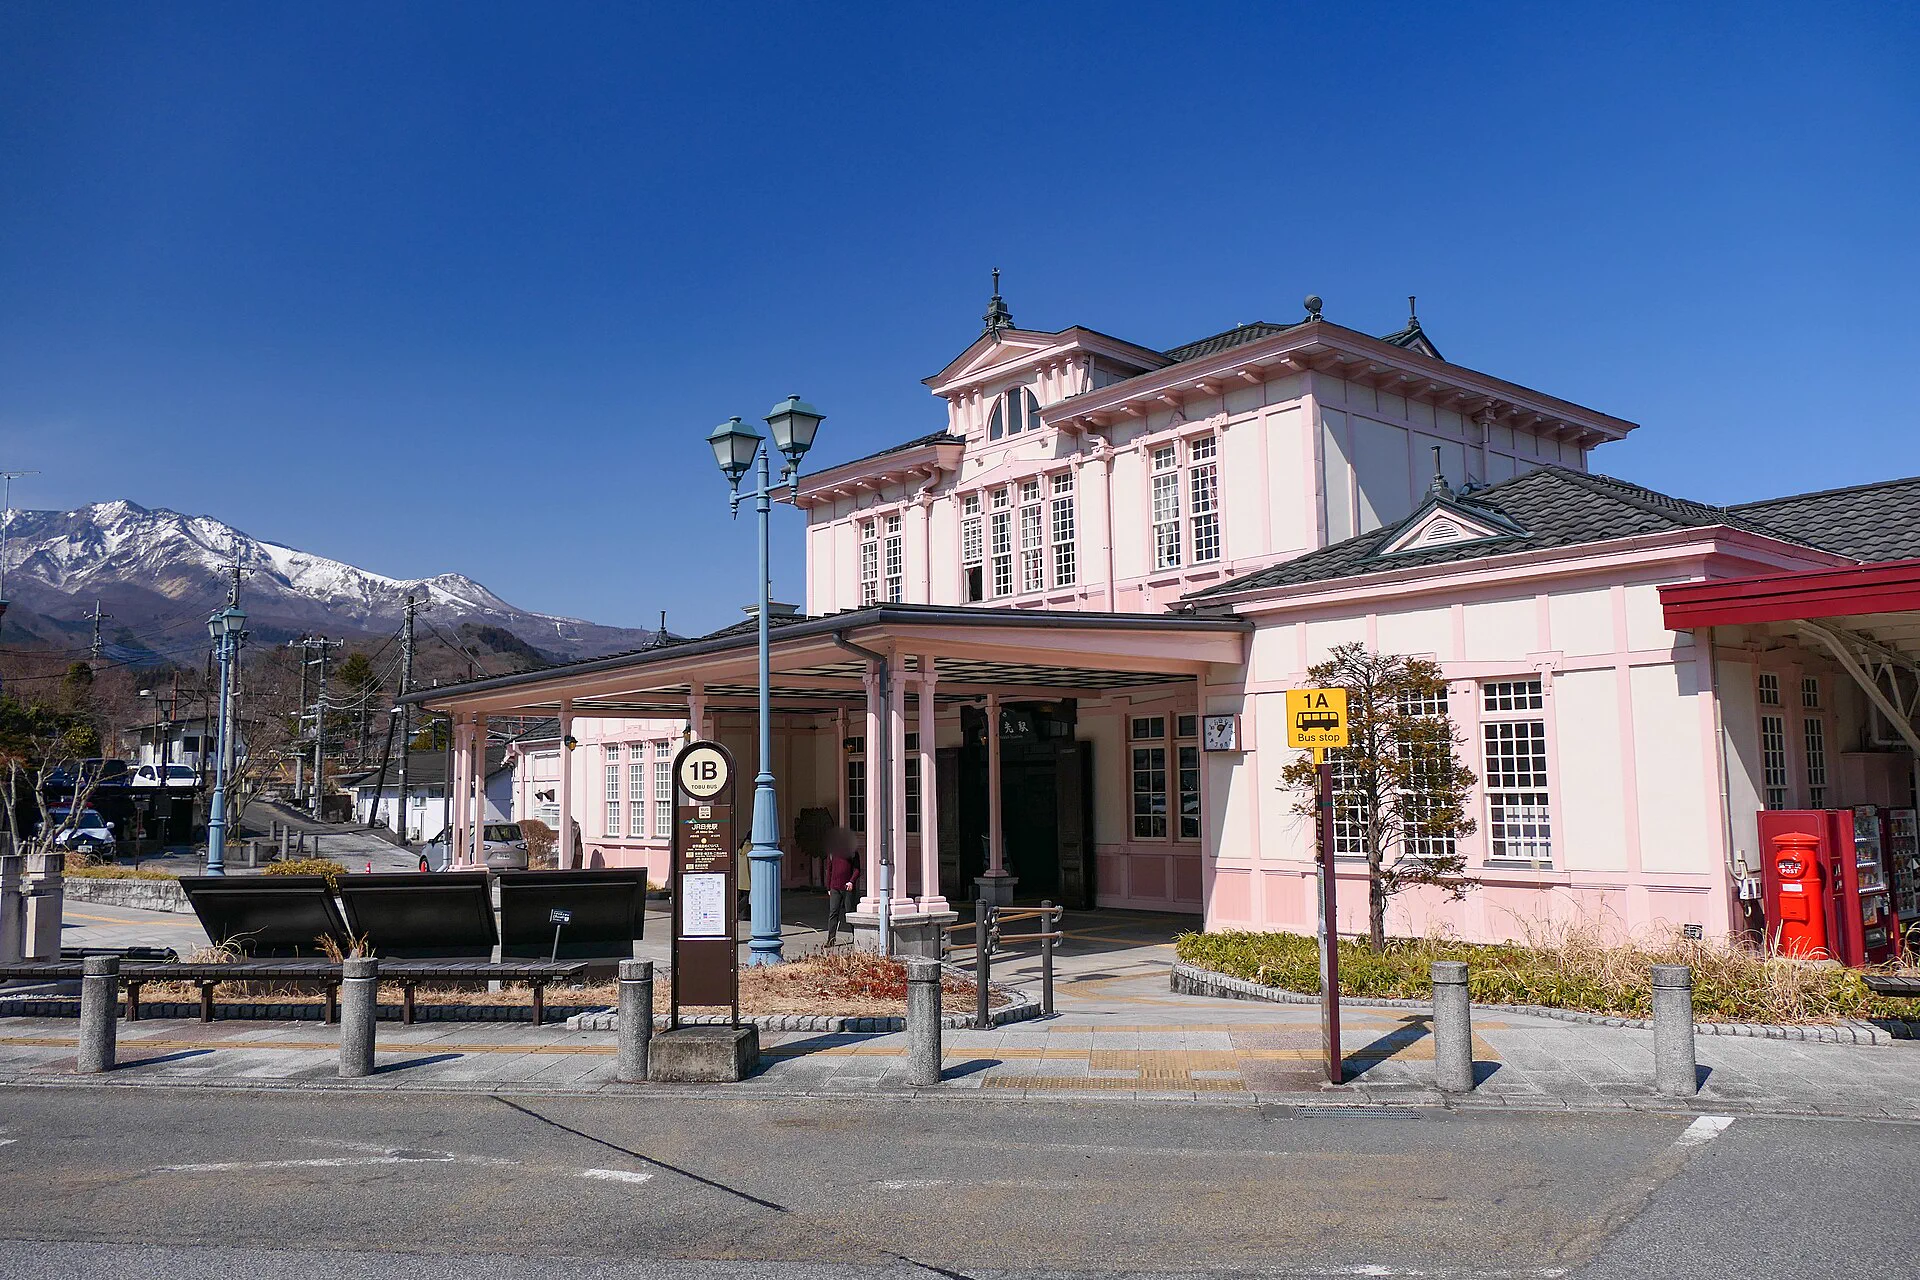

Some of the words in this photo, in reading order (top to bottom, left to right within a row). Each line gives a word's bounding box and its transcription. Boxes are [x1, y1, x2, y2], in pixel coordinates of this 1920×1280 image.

[1303, 693, 1329, 709] 1A
[1297, 733, 1316, 742] Bus
[1318, 733, 1340, 743] stop
[689, 761, 718, 781] 1B
